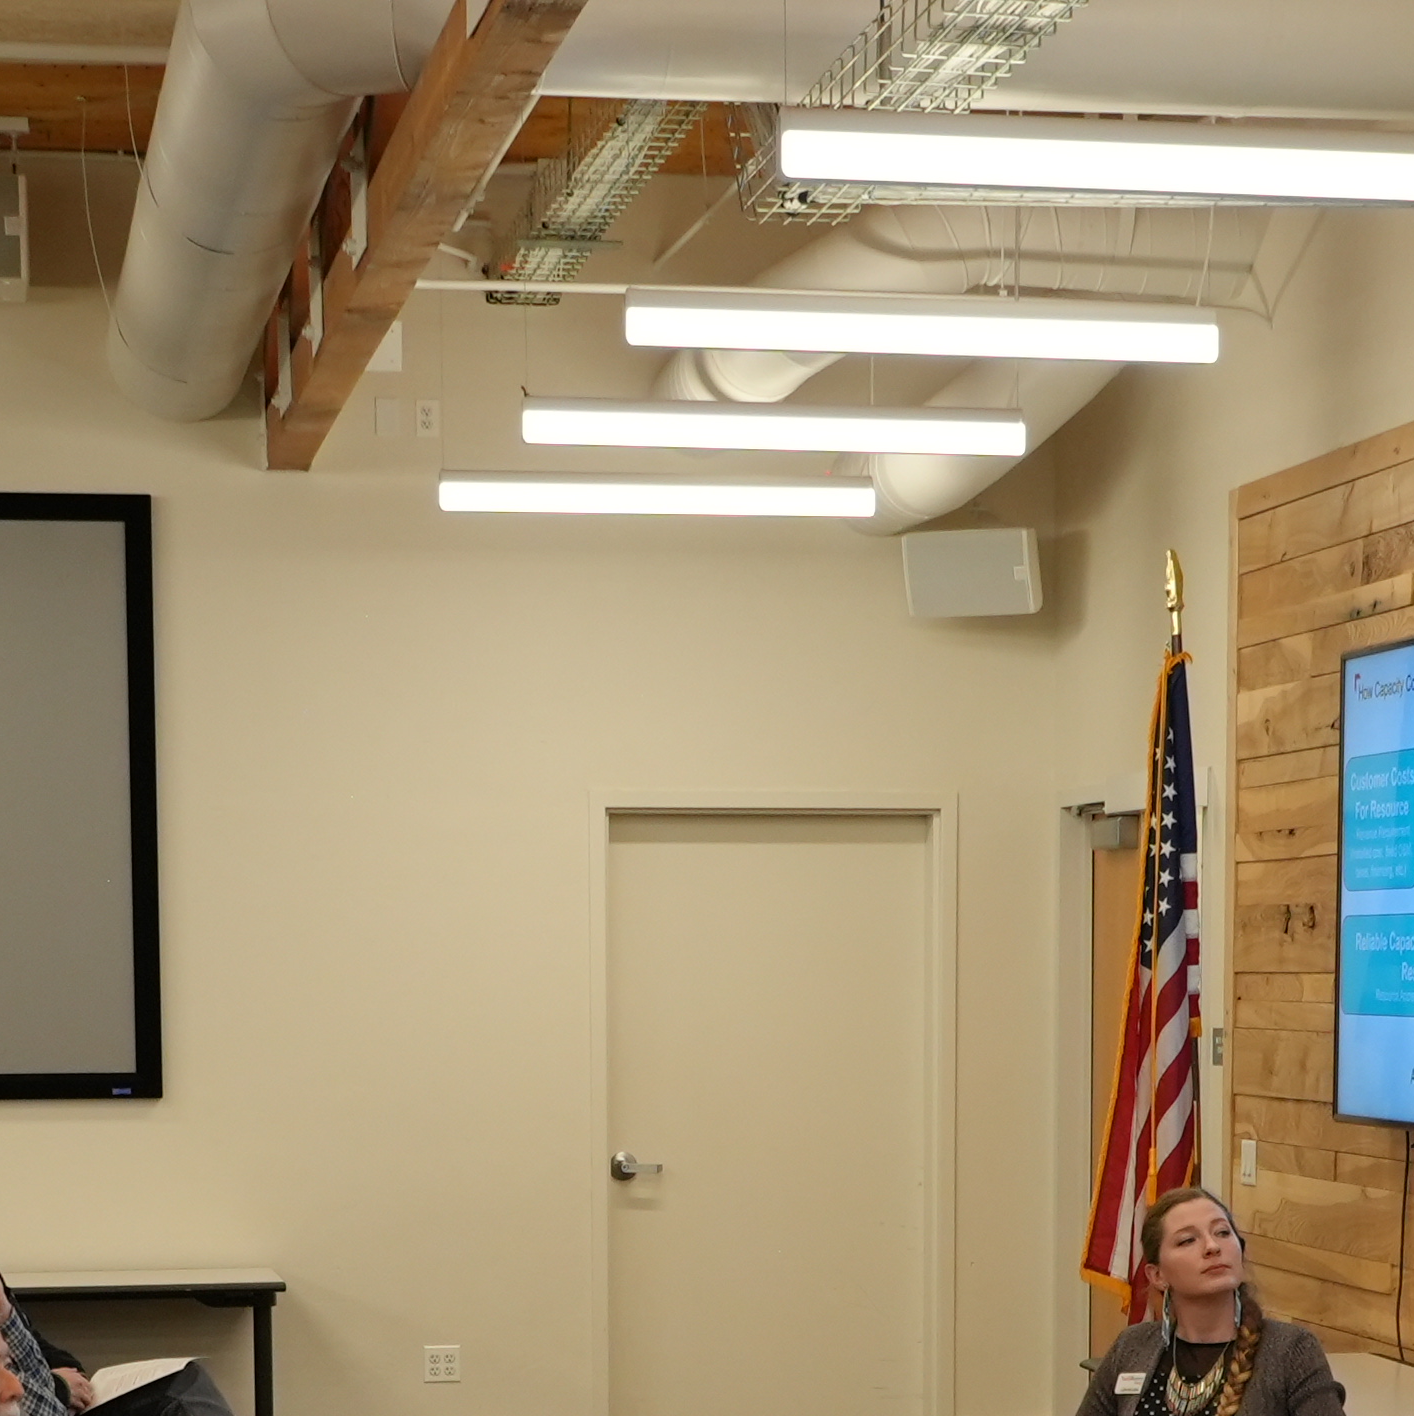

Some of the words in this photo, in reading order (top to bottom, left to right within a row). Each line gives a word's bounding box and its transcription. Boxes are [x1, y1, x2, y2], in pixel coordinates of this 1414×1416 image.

[1375, 678, 1405, 699] Capacity
[1350, 770, 1389, 791] Customer
[1390, 766, 1414, 787] Costs
[1355, 802, 1369, 820] For
[1370, 800, 1409, 819] Resource
[1356, 932, 1387, 951] Reliable
